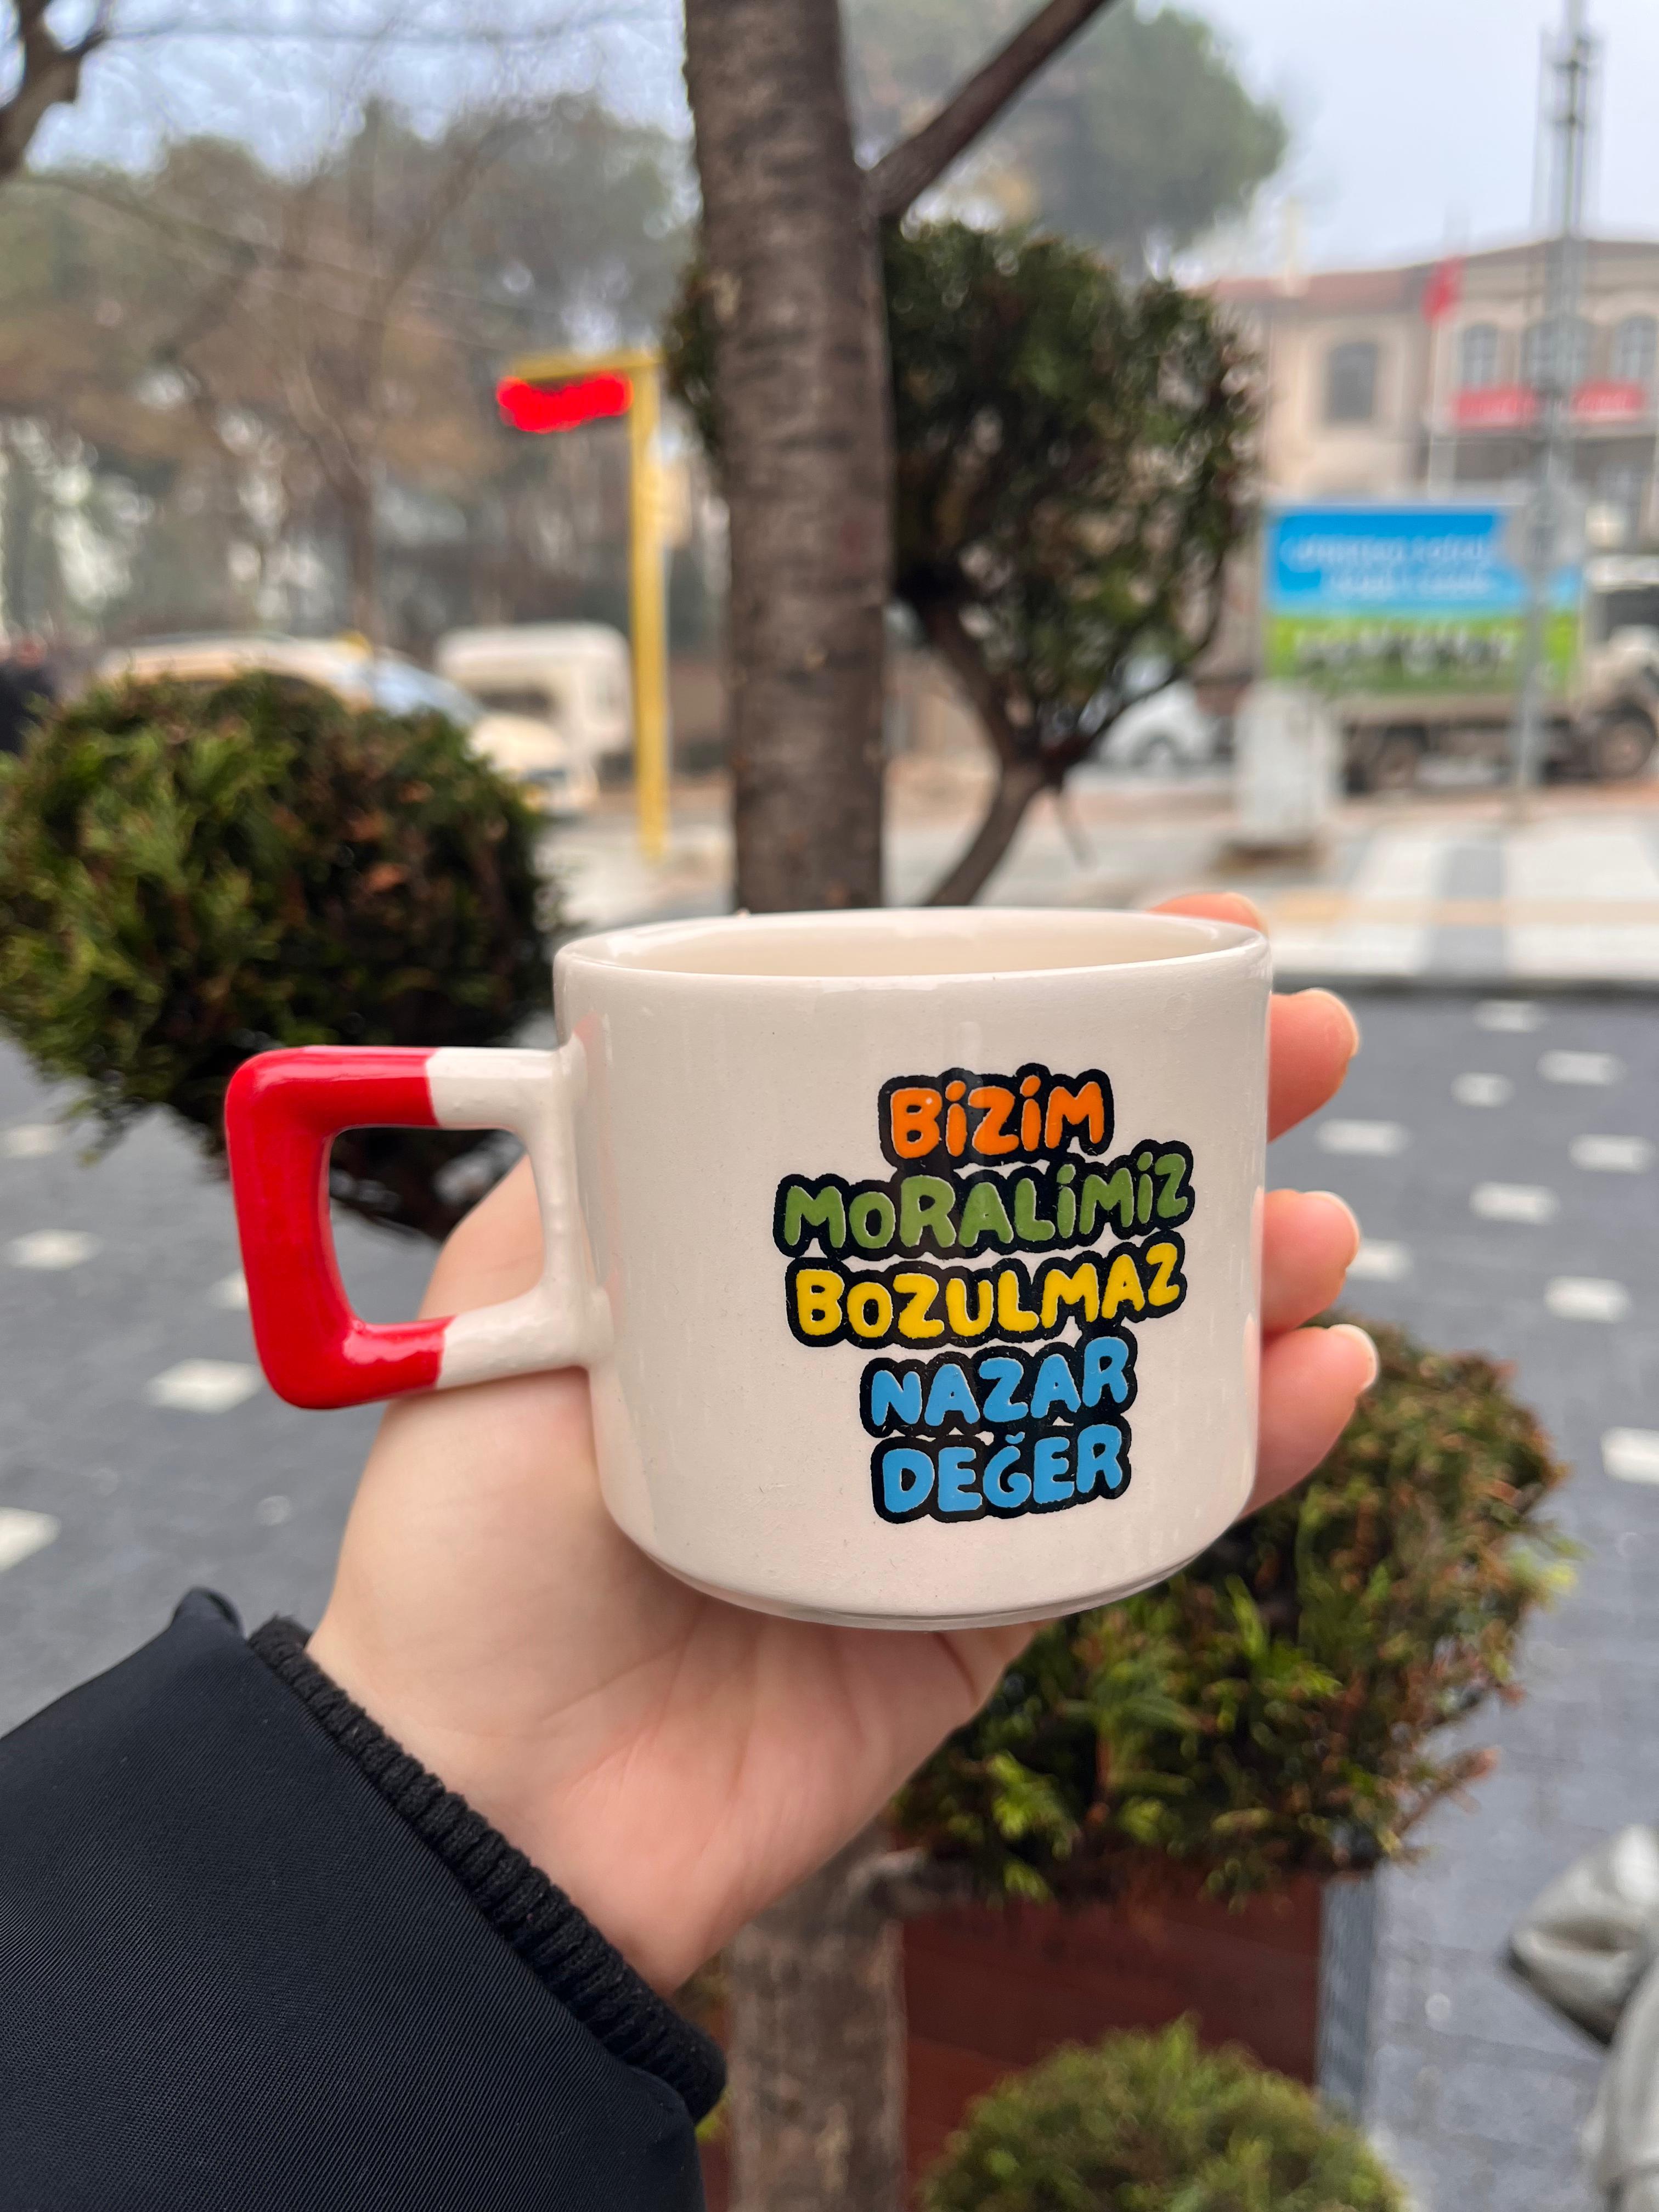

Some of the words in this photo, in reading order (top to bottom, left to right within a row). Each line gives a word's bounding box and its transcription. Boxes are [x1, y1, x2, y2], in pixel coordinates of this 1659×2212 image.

[795, 1242, 1180, 1340] BOZULMAZ
[871, 1336, 1128, 1426] NAZAR
[882, 1424, 1123, 1513] DEĞER
